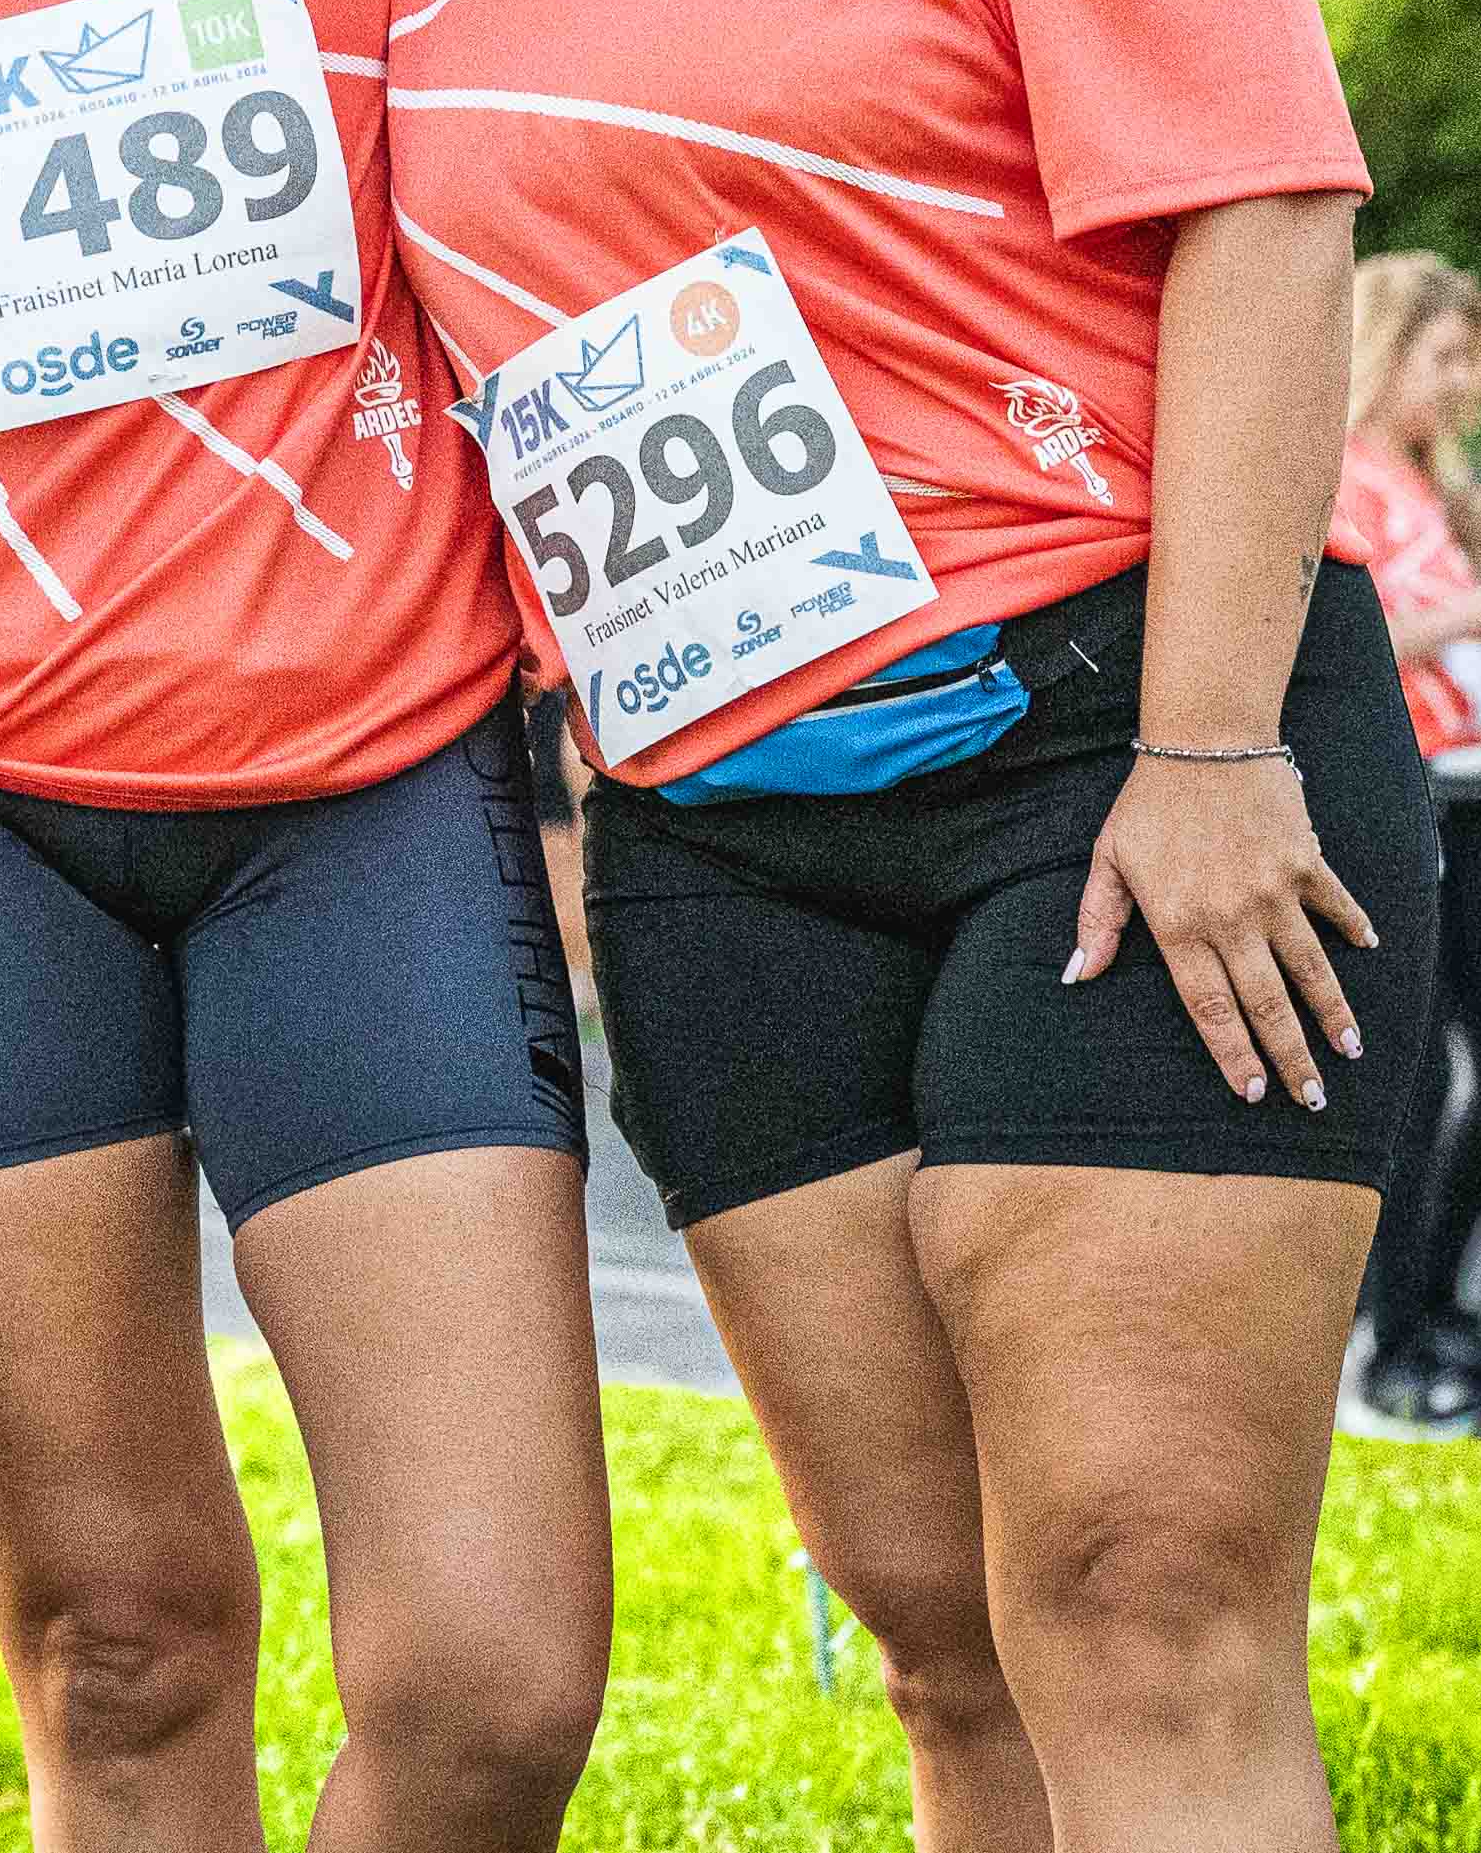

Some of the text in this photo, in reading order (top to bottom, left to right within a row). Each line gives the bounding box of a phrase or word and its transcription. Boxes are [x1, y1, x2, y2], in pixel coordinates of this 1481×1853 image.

[191, 10, 253, 49] 10K
[35, 110, 65, 125] 2026
[79, 92, 138, 114] ROSARIO
[153, 85, 166, 98] 12
[172, 81, 188, 94] DE
[194, 71, 232, 88] ABRIL
[237, 64, 267, 79] 2026
[112, 257, 187, 293] María
[194, 243, 279, 276] Lorena
[237, 311, 298, 335] POWER
[687, 298, 728, 338] 4K
[1, 329, 140, 397] osde
[352, 399, 422, 441] ARDEC
[500, 378, 571, 461] 15K
[542, 442, 568, 464] NORTE
[598, 401, 645, 430] ROSARIO
[655, 388, 668, 402] 12
[671, 380, 686, 395] DE
[690, 363, 724, 384] ABRIL
[512, 359, 836, 617] 5296
[584, 511, 828, 648] Fraisinet Valeria Mariana
[790, 581, 852, 619] POWER
[616, 641, 713, 715] osde
